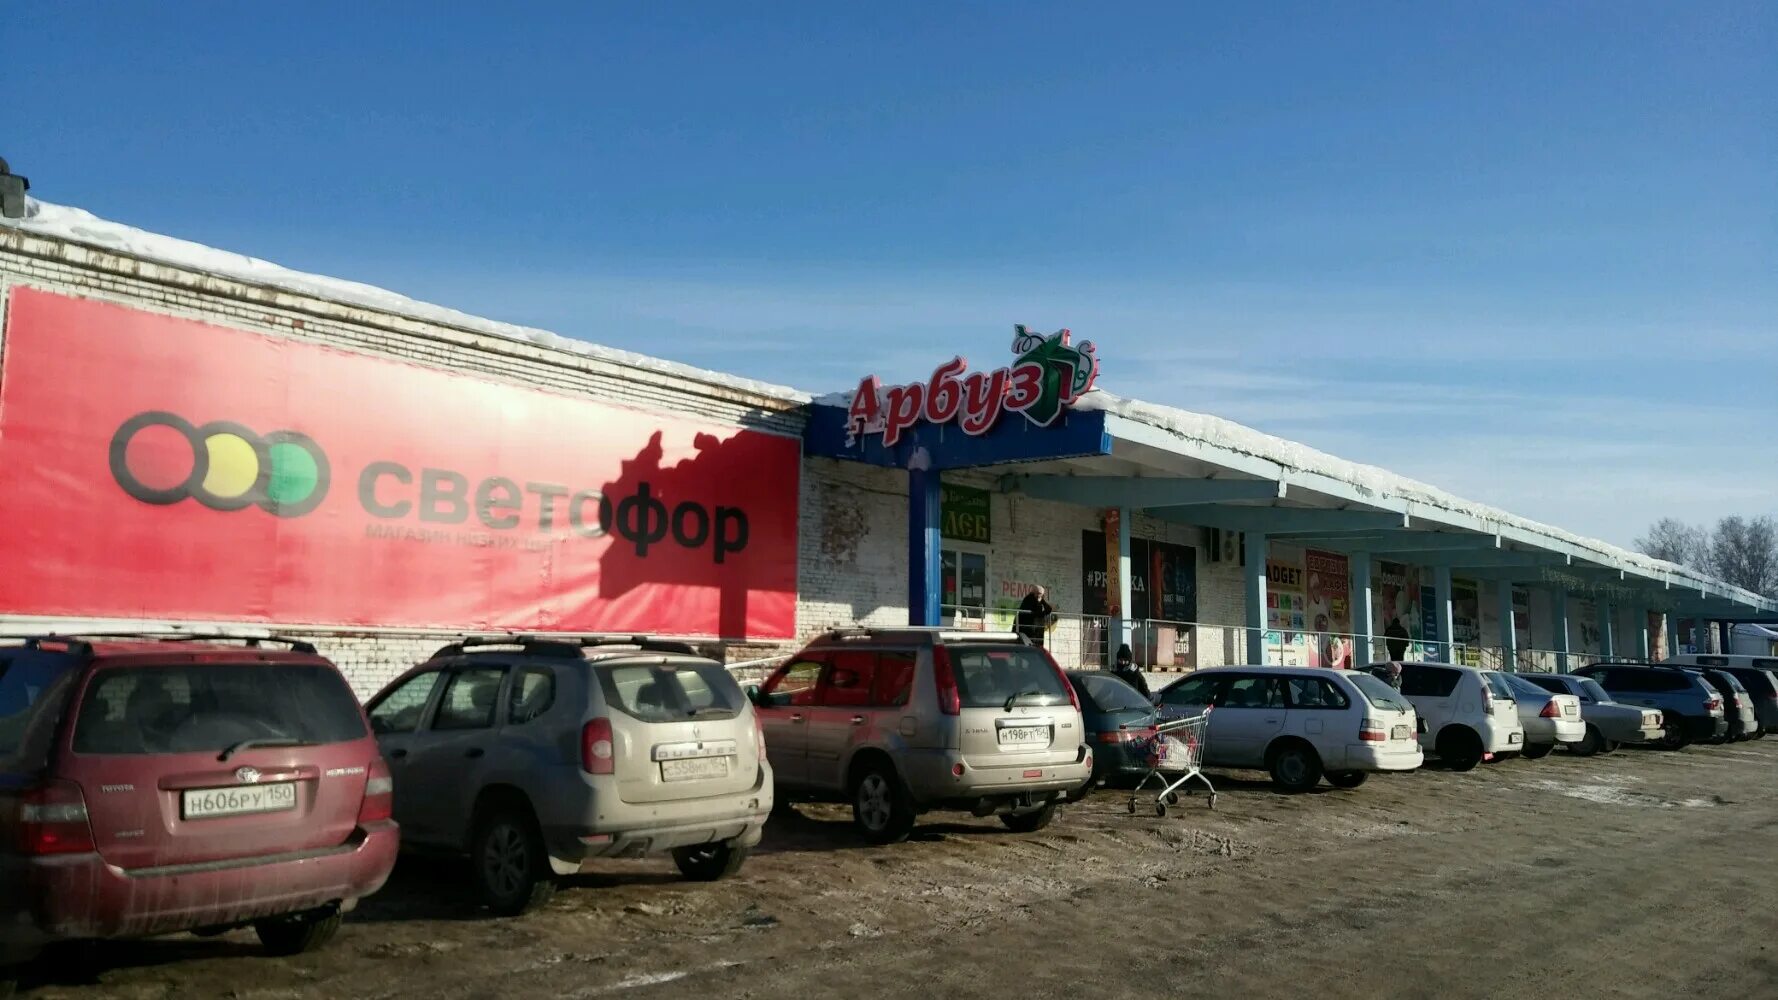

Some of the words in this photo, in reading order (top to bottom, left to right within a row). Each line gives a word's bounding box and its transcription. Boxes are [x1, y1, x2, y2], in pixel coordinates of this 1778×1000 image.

[849, 356, 1044, 448] Арбуз
[365, 523, 452, 544] МАГАЗИН
[455, 530, 518, 549] НИЗКИХ
[943, 511, 988, 540] ЛЕБ
[1265, 563, 1302, 586] ADGET
[1002, 580, 1052, 601] РЕМОТ
[658, 746, 737, 758] DUSTER
[102, 784, 135, 793] TOYOTA
[190, 790, 262, 813] Н606РУ
[266, 786, 291, 800] 150
